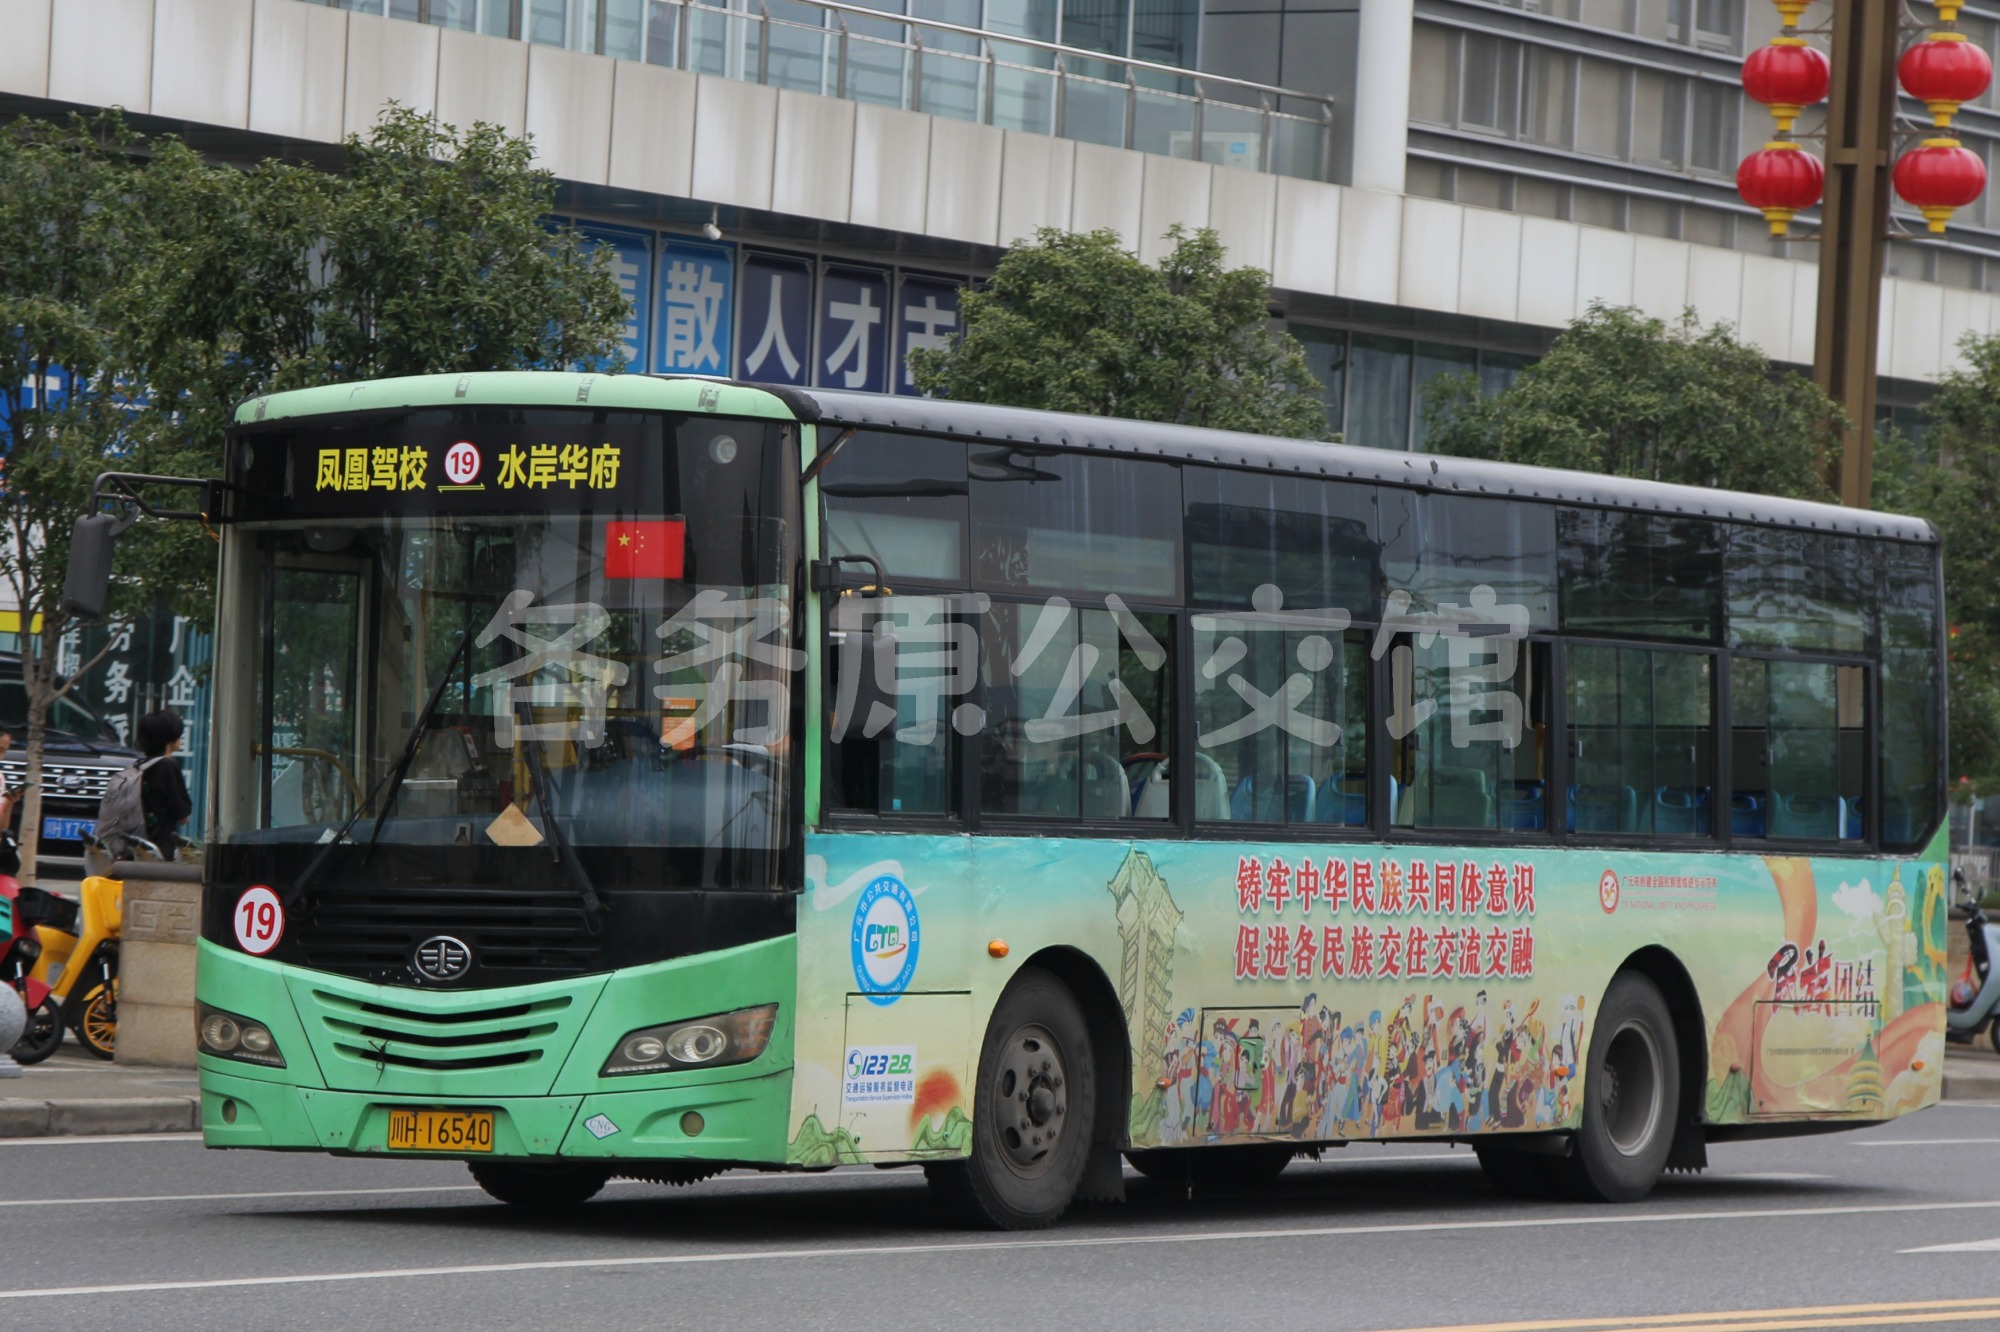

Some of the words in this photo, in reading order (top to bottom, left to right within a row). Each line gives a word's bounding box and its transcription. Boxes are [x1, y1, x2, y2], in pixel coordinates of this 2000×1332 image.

[316, 446, 428, 491] 凤凰驾校
[450, 451, 474, 475] 19
[497, 444, 621, 490] 水岸华府
[1236, 858, 1536, 914] 铸牢中华民族共同体意识
[242, 901, 276, 941] 19
[853, 880, 918, 943] 广元市公共交通有限公司
[1235, 924, 1534, 977] 促进各民族交往交流交融
[1767, 939, 1876, 1018] 民族团结
[861, 1054, 912, 1075] 12328
[845, 1080, 914, 1094] 交通运输服务监督电话
[391, 1115, 491, 1146] 川H·16540
[589, 1119, 611, 1131] CNG
